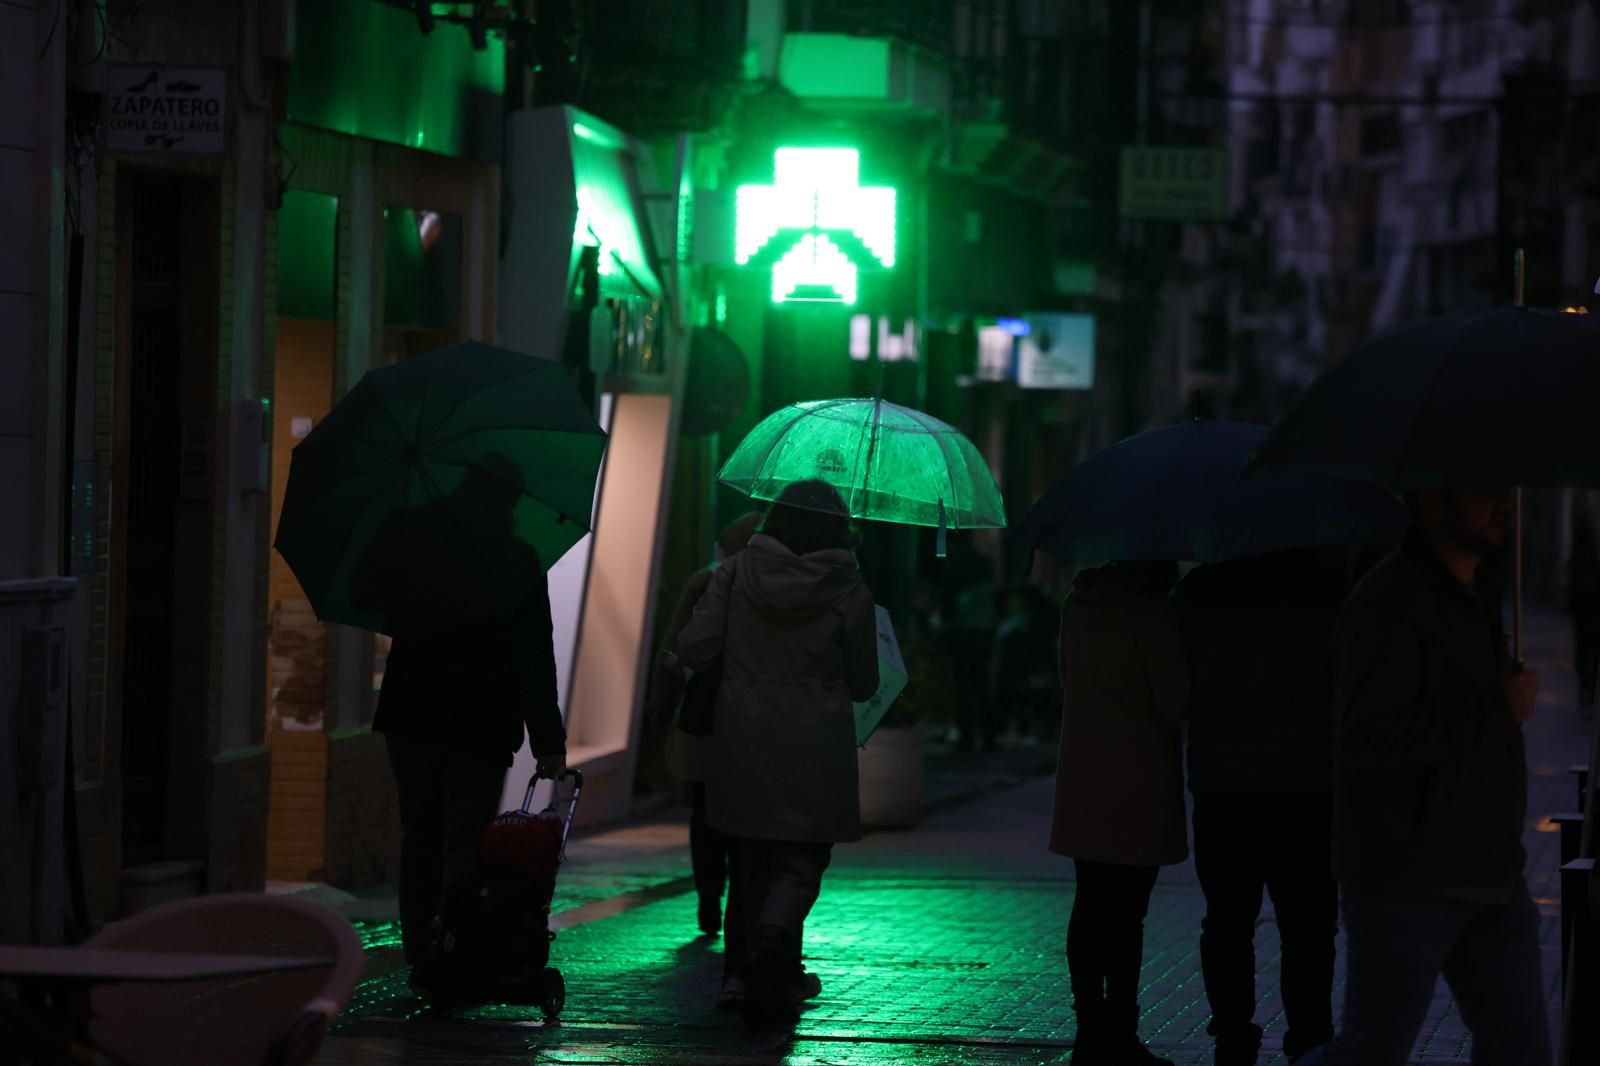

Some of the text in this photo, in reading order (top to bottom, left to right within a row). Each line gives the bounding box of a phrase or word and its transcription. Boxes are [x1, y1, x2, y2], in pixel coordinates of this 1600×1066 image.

[111, 95, 220, 117] ZAPATERO
[110, 119, 220, 132] COPIA DE LLAVES
